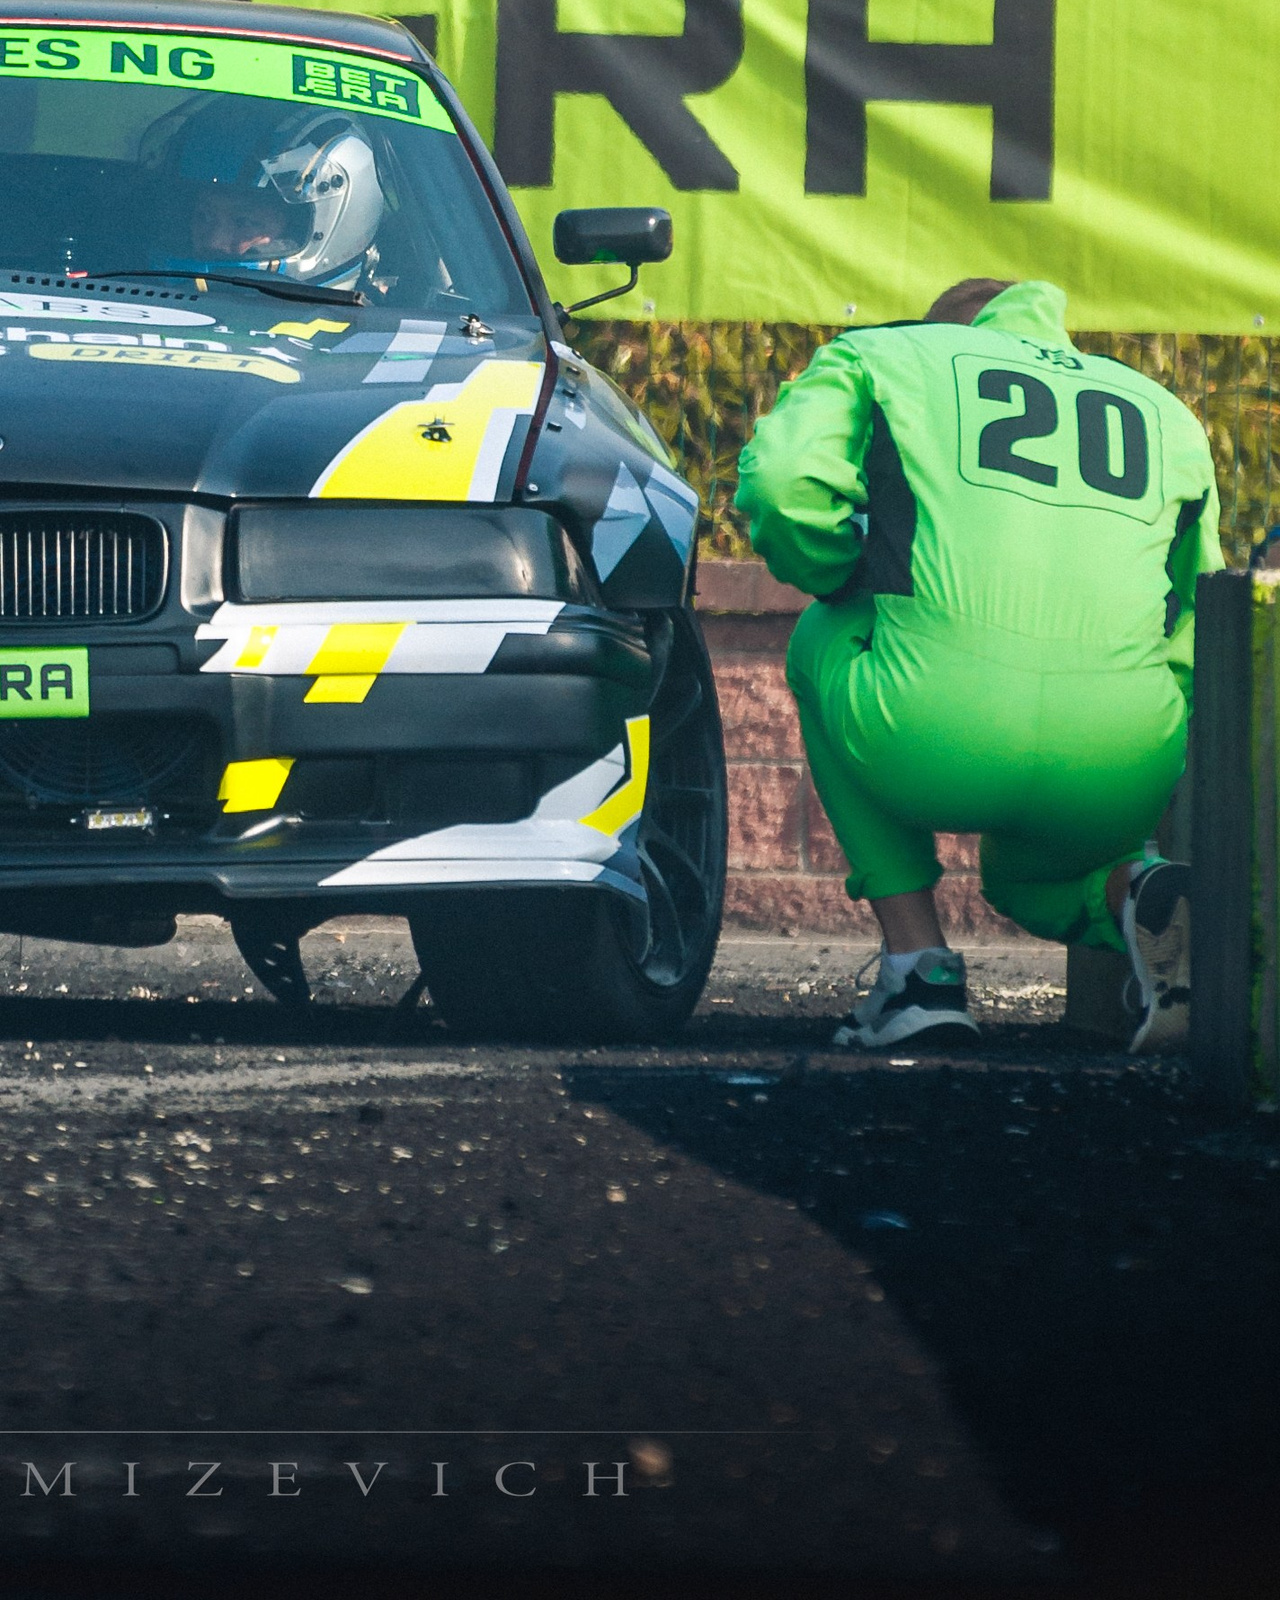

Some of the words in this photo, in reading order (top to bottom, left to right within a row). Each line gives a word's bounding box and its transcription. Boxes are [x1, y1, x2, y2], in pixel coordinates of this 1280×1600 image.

[110, 40, 216, 81] NG
[305, 60, 407, 93] BET
[70, 347, 264, 370] DRIFT
[977, 369, 1149, 500] 20
